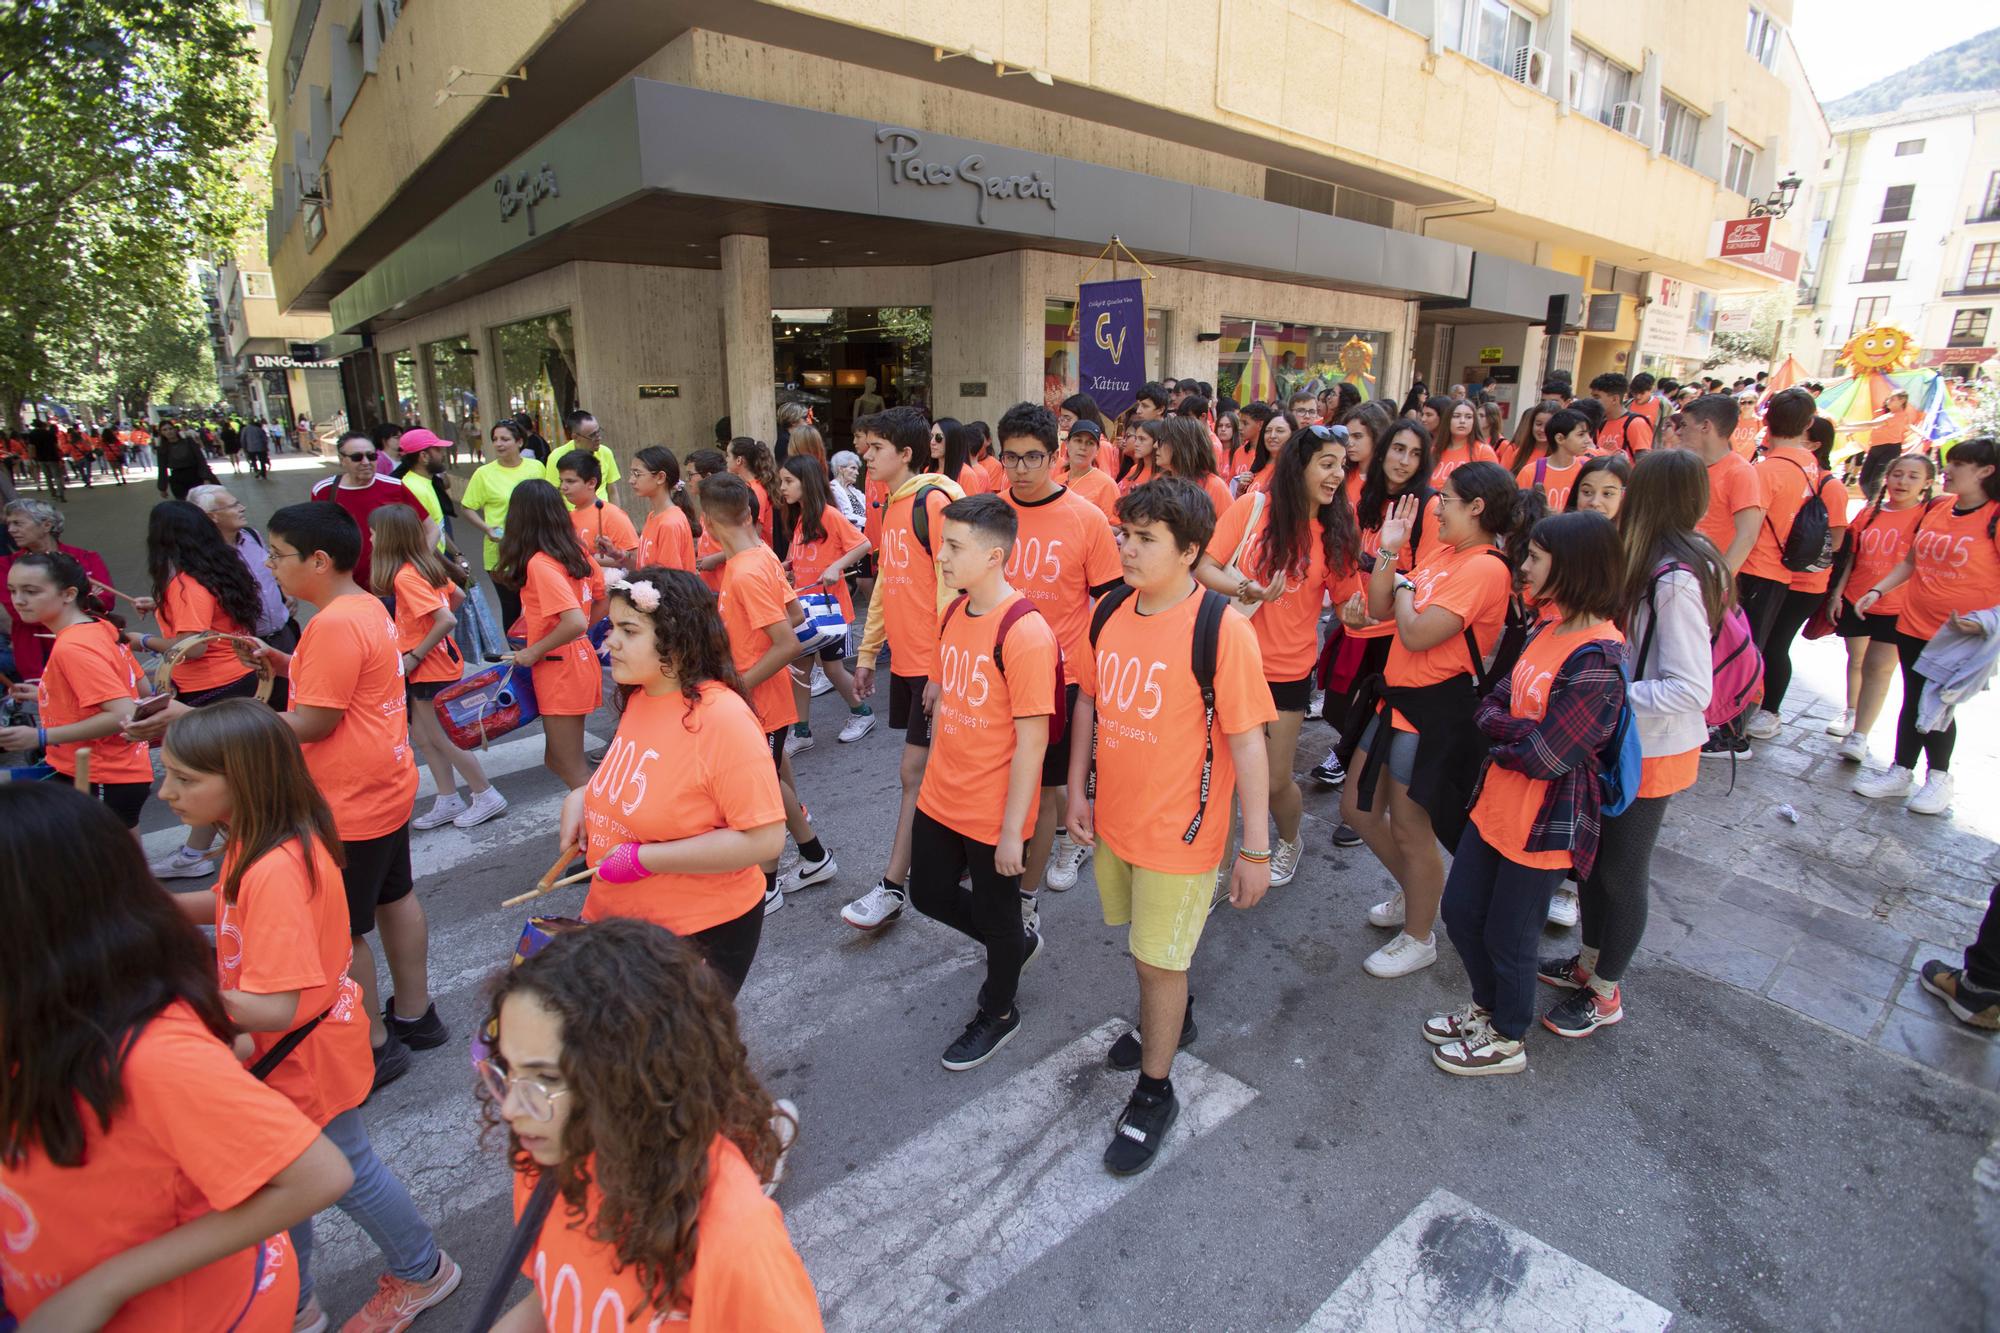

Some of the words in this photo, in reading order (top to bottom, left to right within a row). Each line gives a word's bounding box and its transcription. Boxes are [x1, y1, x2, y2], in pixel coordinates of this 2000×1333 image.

[877, 127, 953, 185] Paco
[1726, 241, 1760, 250] GENERALI
[1089, 375, 1130, 391] Xàtiva
[1096, 649, 1168, 720] 1005
[1119, 724, 1146, 742] poses
[1147, 731, 1158, 745] tu
[1121, 1123, 1147, 1143] PUMA
